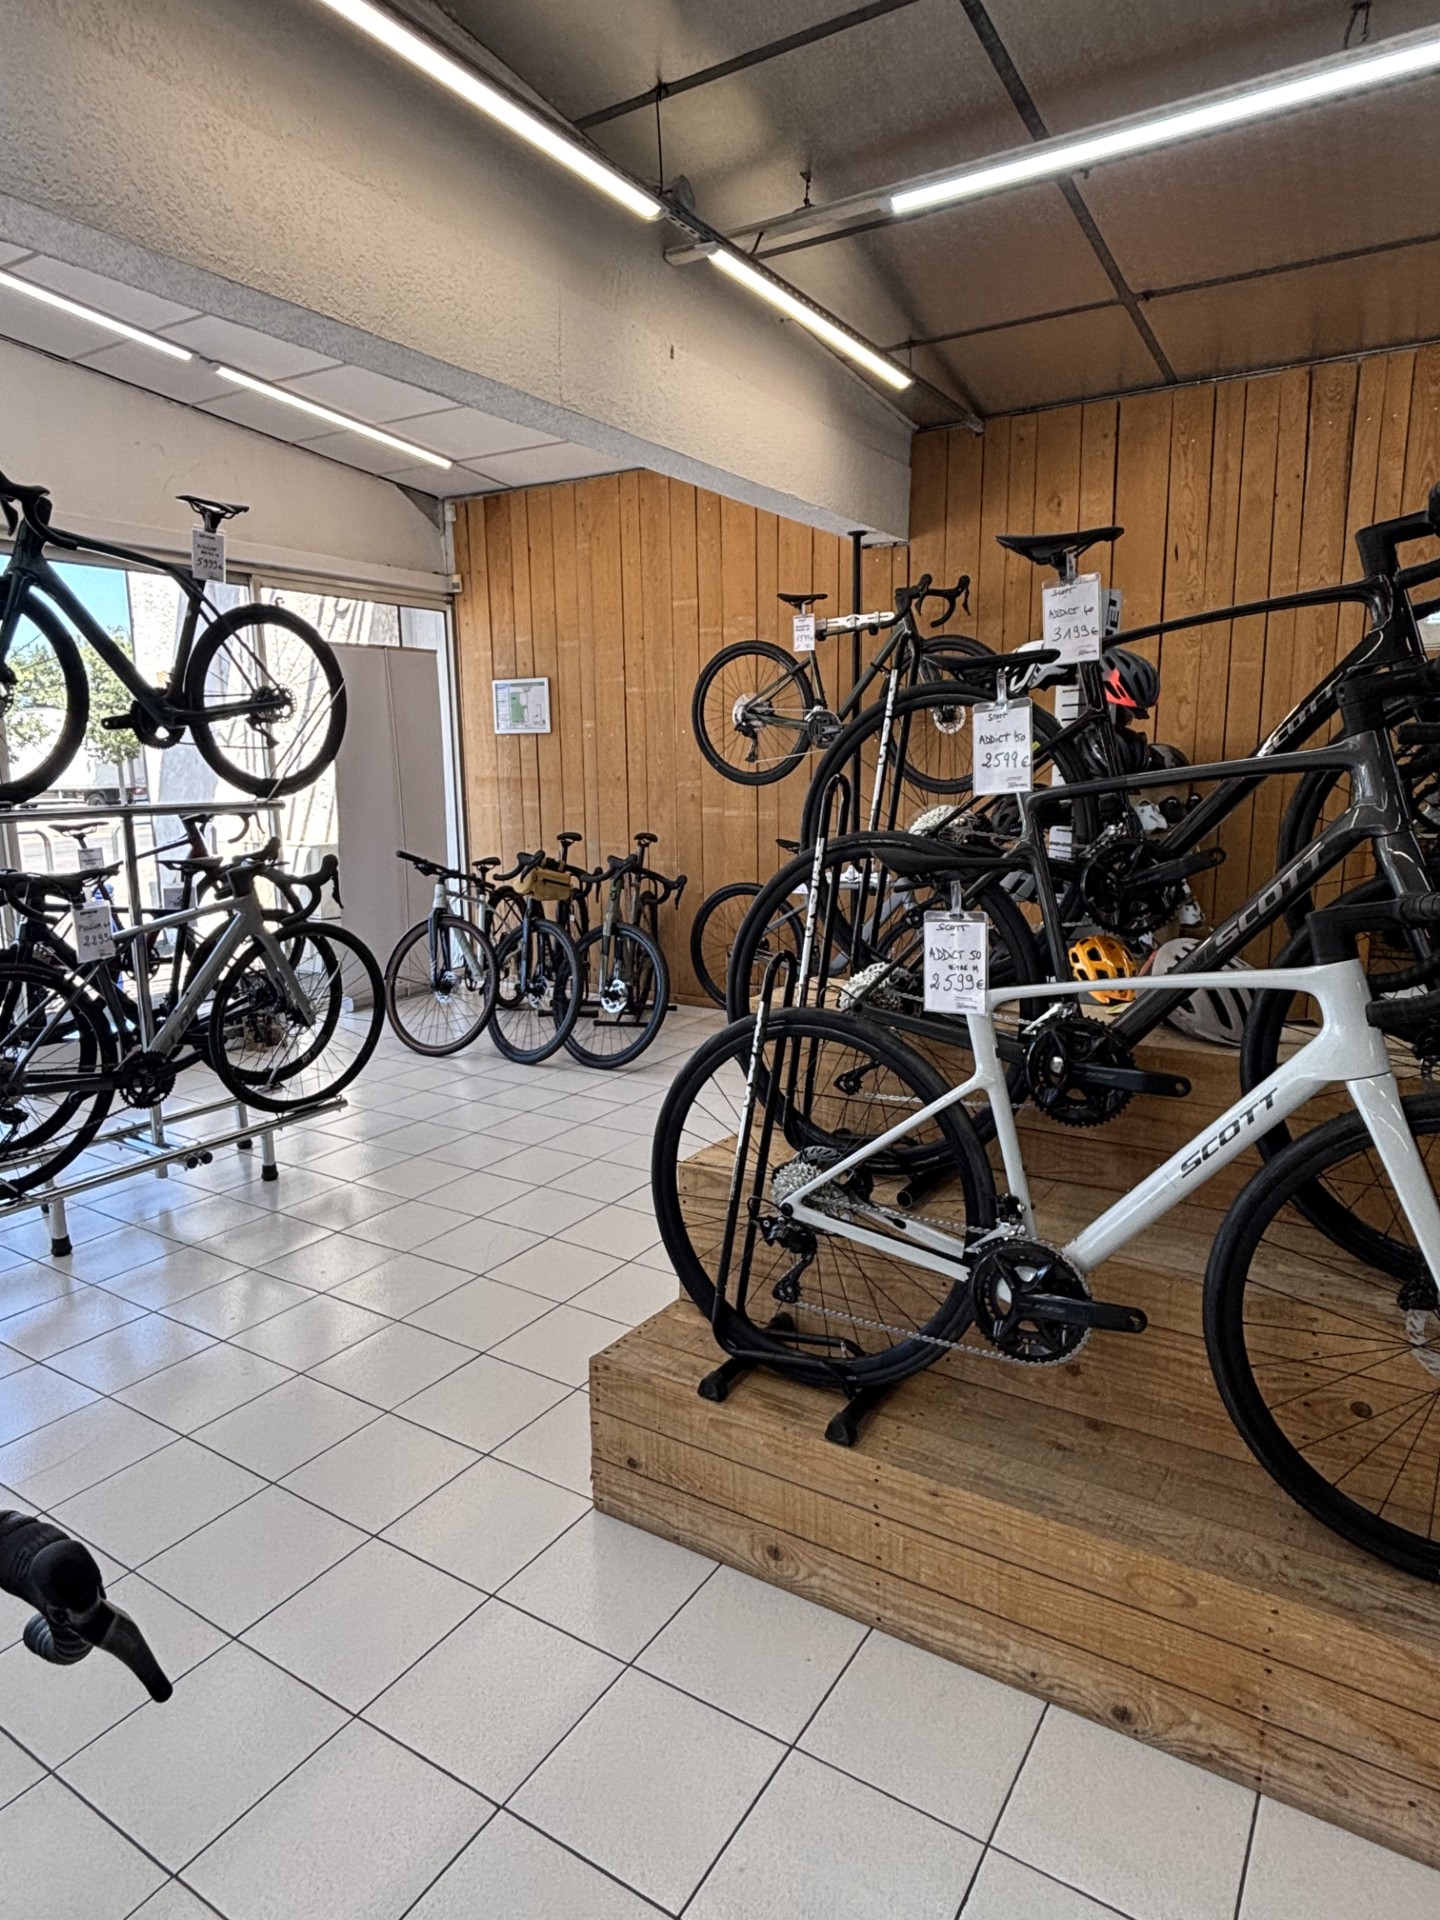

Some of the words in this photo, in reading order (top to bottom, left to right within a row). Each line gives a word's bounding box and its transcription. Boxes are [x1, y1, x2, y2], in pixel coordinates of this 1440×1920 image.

[1052, 624, 1099, 642] 3199€
[1214, 843, 1325, 953] SCOTT
[935, 922, 970, 932] SCOTT
[968, 950, 982, 960] 50
[929, 972, 985, 992] 2599€
[1179, 1086, 1279, 1180] SCOTT
